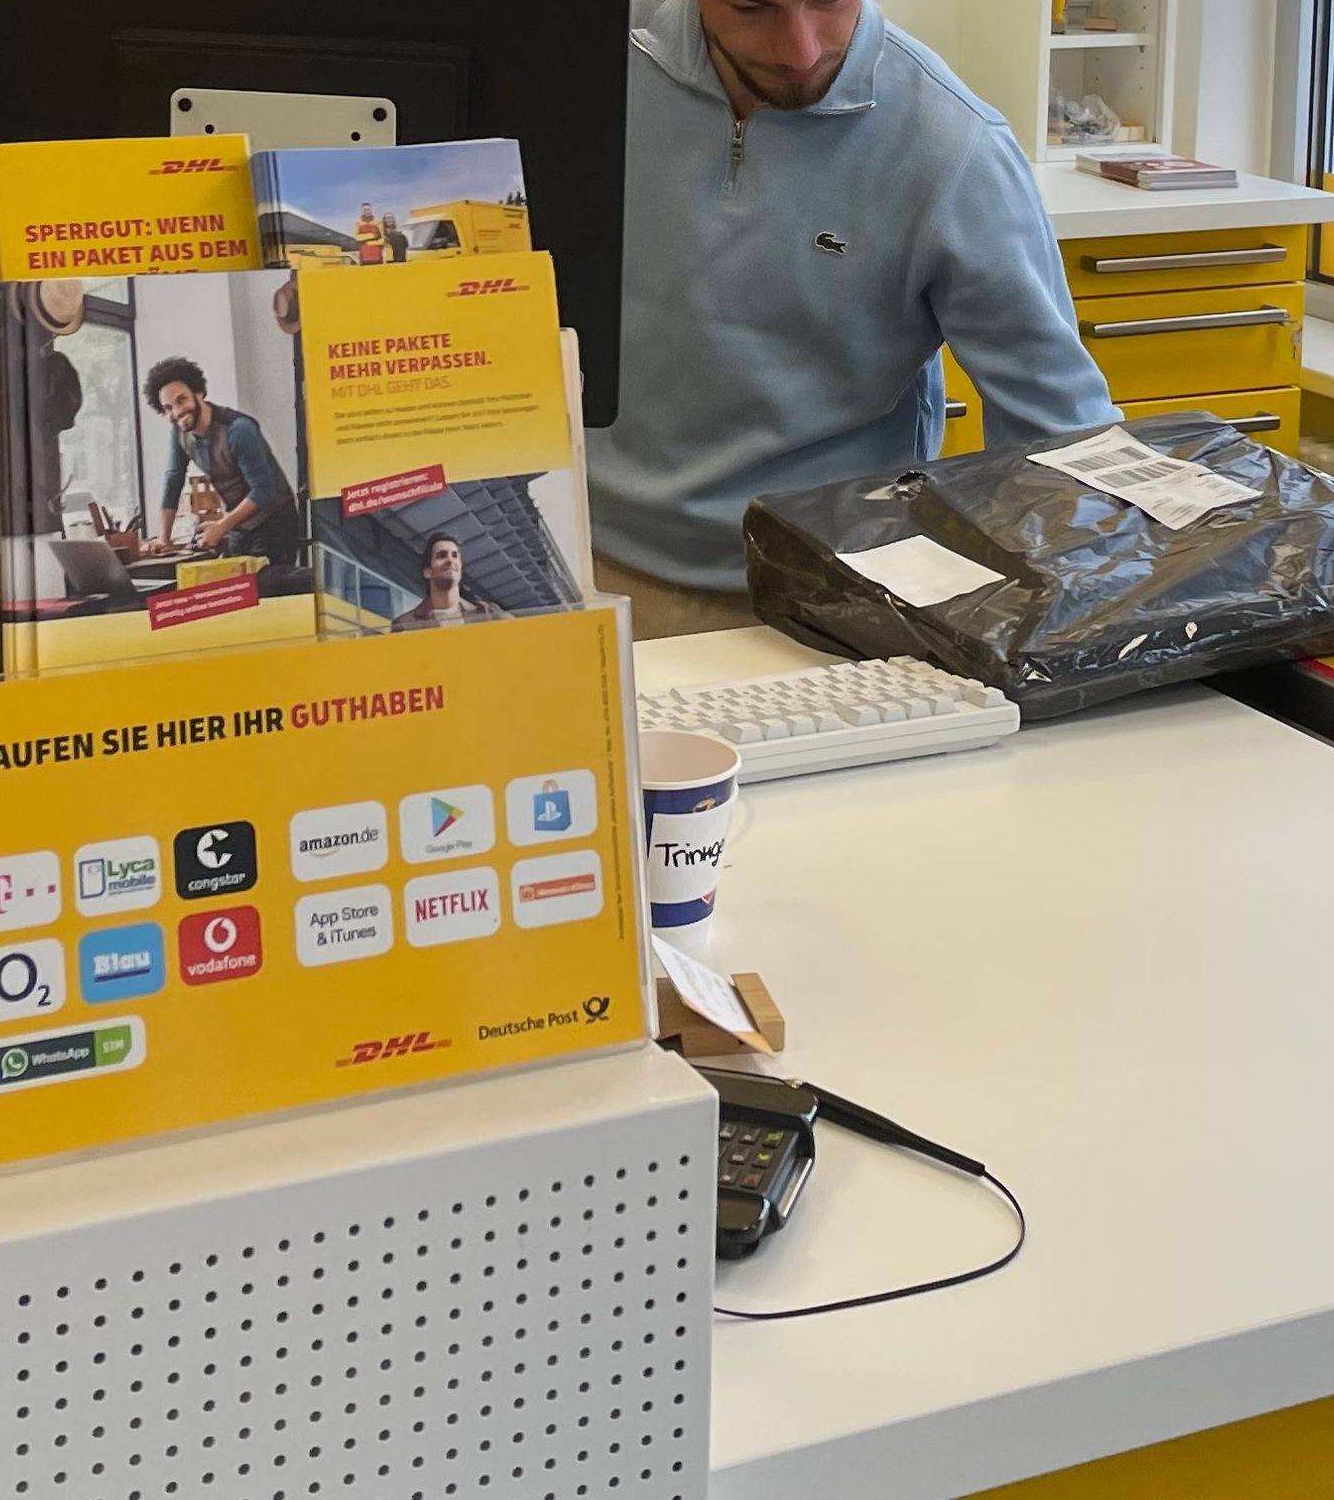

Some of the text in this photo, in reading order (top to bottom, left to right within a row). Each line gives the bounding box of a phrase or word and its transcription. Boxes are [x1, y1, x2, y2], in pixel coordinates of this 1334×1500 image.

[155, 158, 225, 174] DHL
[25, 214, 225, 243] SPERRGUT: WENN
[28, 238, 248, 270] EIN PAKET AUS DEM
[458, 278, 519, 296] DHL
[328, 333, 451, 359] KEINE PAKETE
[330, 351, 492, 380] MEHR VERPASSEN.
[331, 386, 354, 399] MIT
[357, 382, 383, 397] DHL
[101, 725, 149, 755] SIE
[156, 715, 225, 747] HIER
[233, 707, 284, 737] IHR
[290, 685, 445, 730] GUTHABEN
[299, 826, 379, 852] amazon.de
[107, 857, 156, 879] Lyca
[108, 874, 156, 889] mobile
[187, 872, 246, 892] congstar
[310, 903, 379, 927] App Store
[415, 889, 489, 923] NETFLIX
[317, 926, 376, 946] & iTunes
[93, 951, 151, 976] Blau
[187, 953, 257, 977] vodafone
[478, 1011, 578, 1040] Deutsche Post
[32, 1047, 90, 1066] WhatsApp
[352, 1031, 435, 1064] DHL
